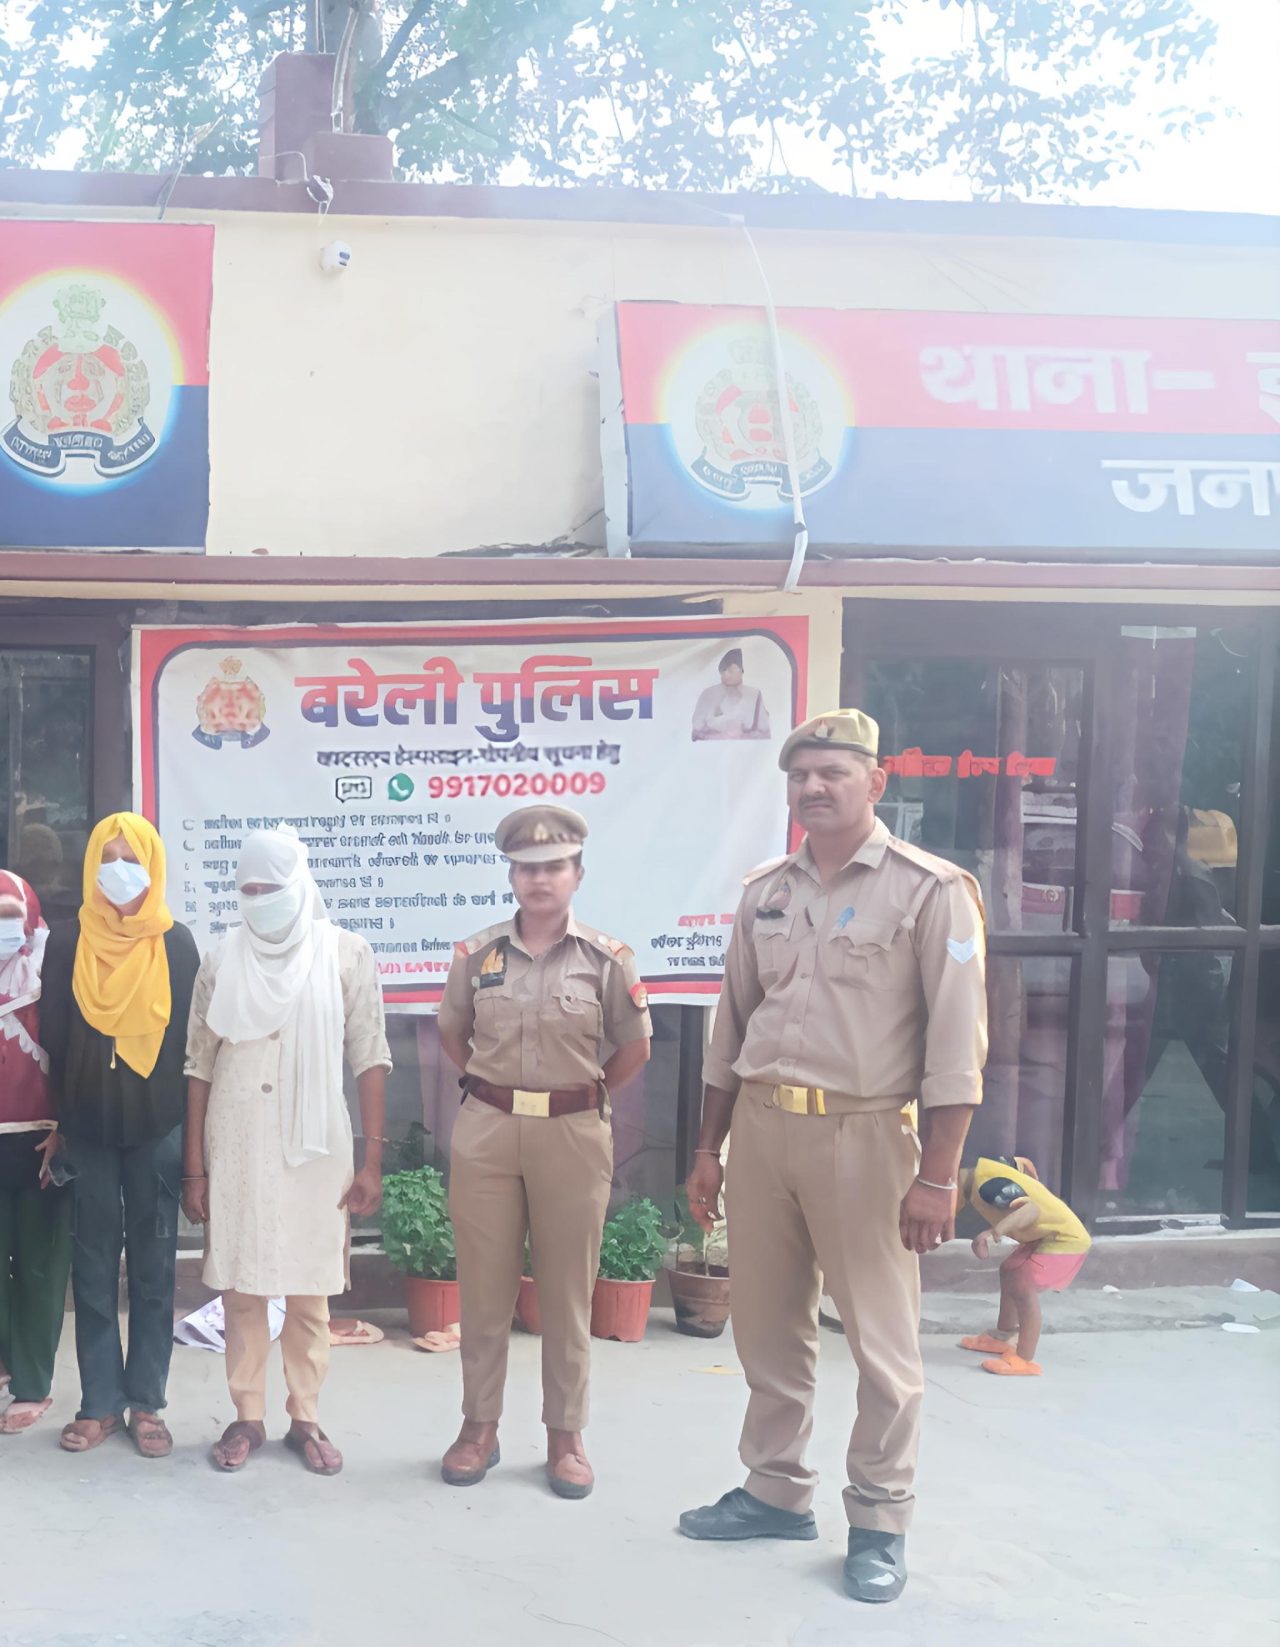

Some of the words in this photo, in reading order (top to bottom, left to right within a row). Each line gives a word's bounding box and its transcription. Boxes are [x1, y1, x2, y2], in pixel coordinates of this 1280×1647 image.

[919, 345, 1216, 414] थाना-
[1101, 459, 1280, 516] जन
[294, 657, 465, 727] बरेली
[473, 655, 660, 742] पुलिस
[428, 771, 606, 798] 9917020009
